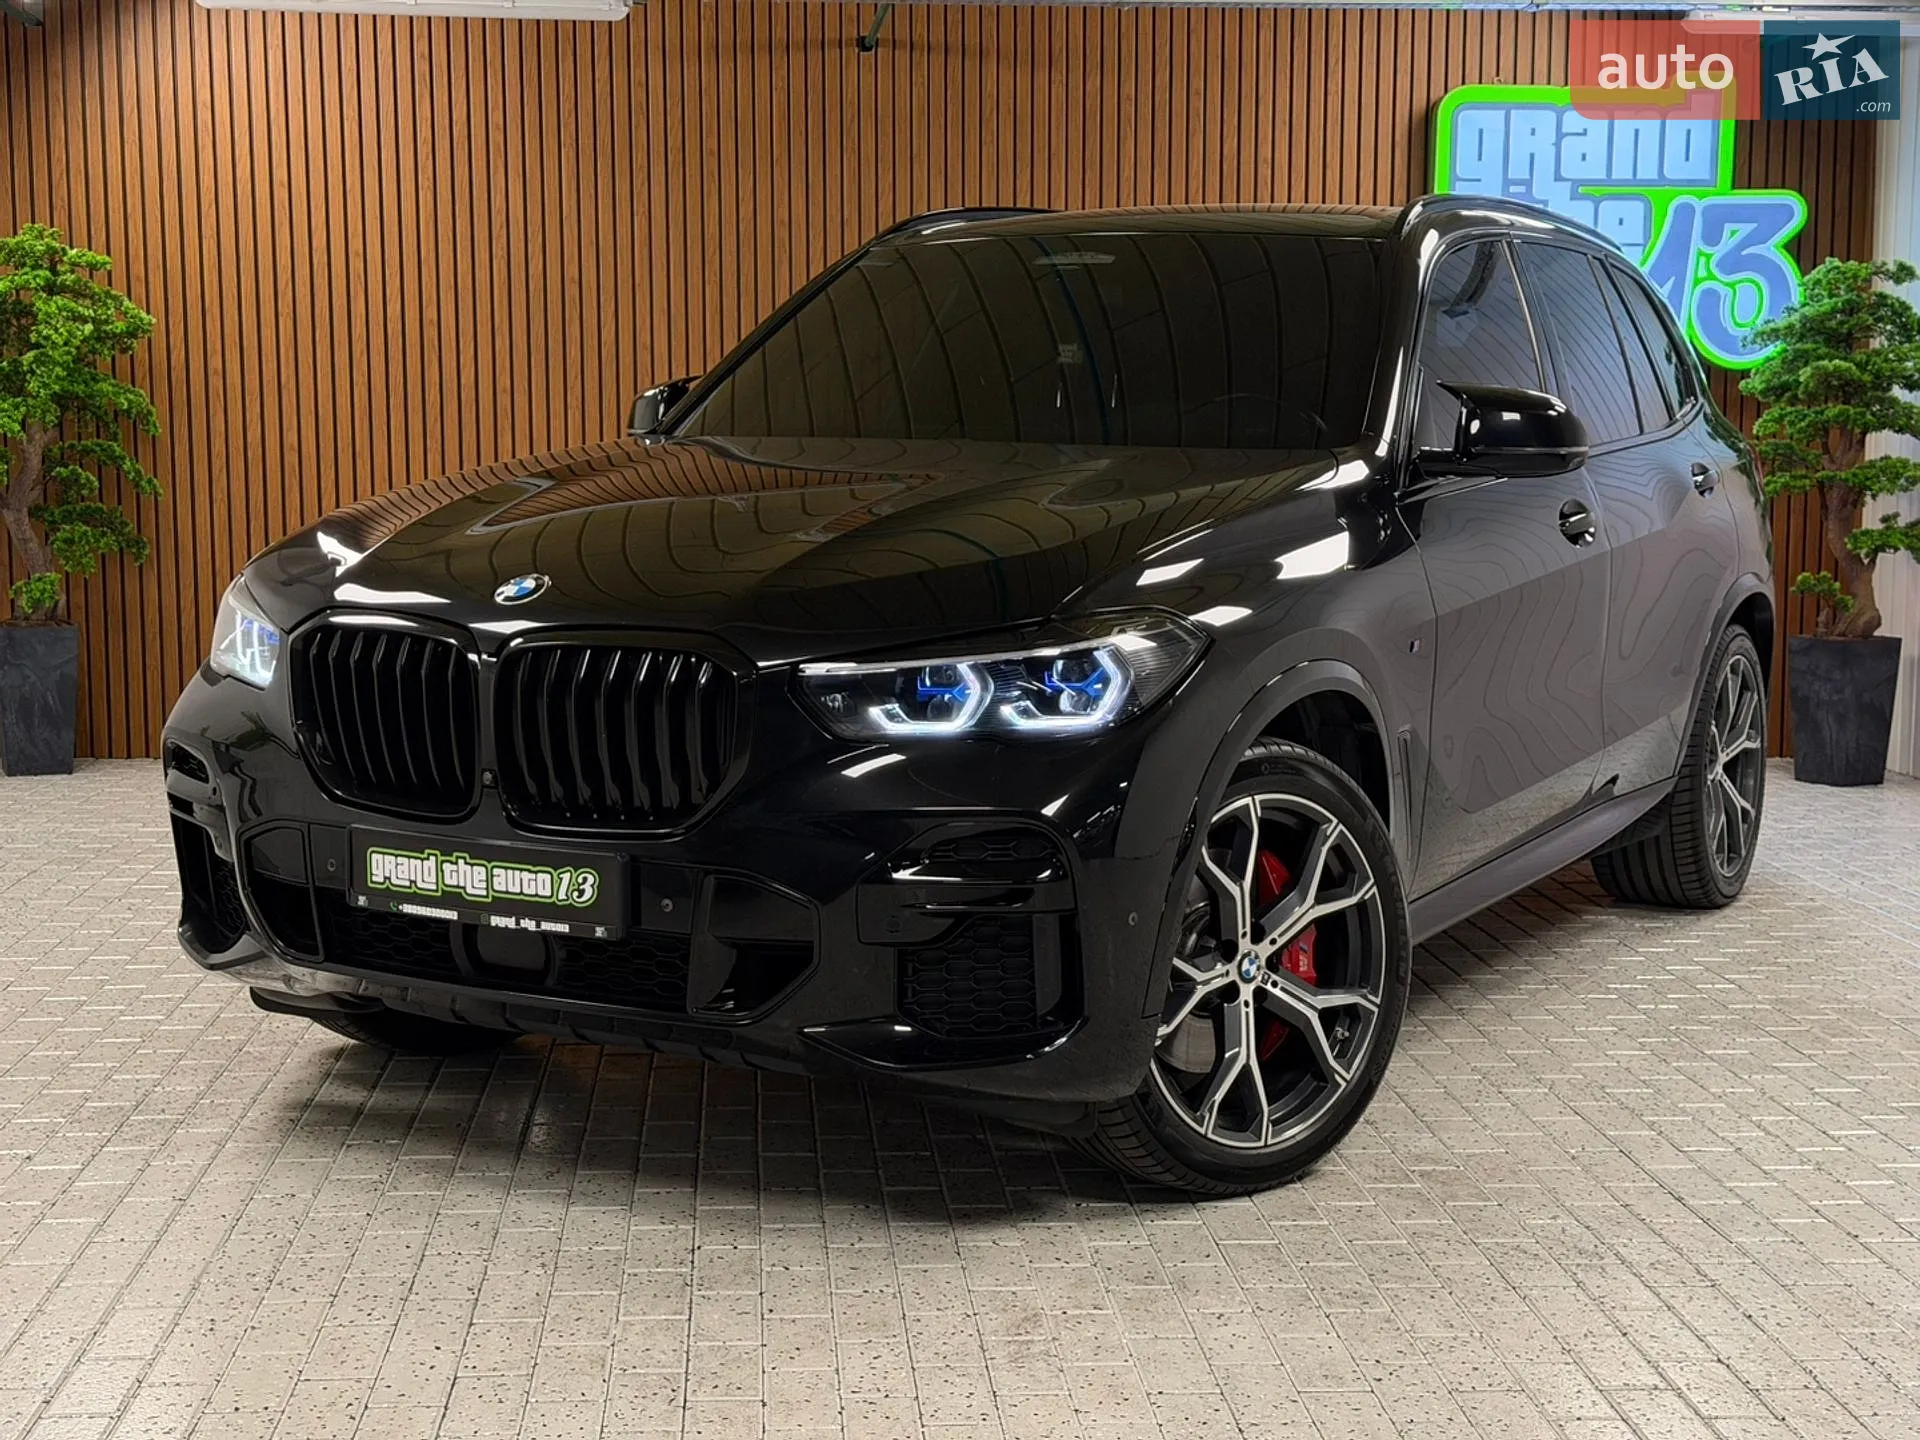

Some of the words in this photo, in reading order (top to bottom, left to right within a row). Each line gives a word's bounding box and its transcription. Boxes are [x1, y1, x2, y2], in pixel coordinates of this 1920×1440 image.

[370, 852, 437, 890] grand
[442, 854, 488, 895] the
[492, 867, 552, 897] auto
[556, 868, 596, 904] 13
